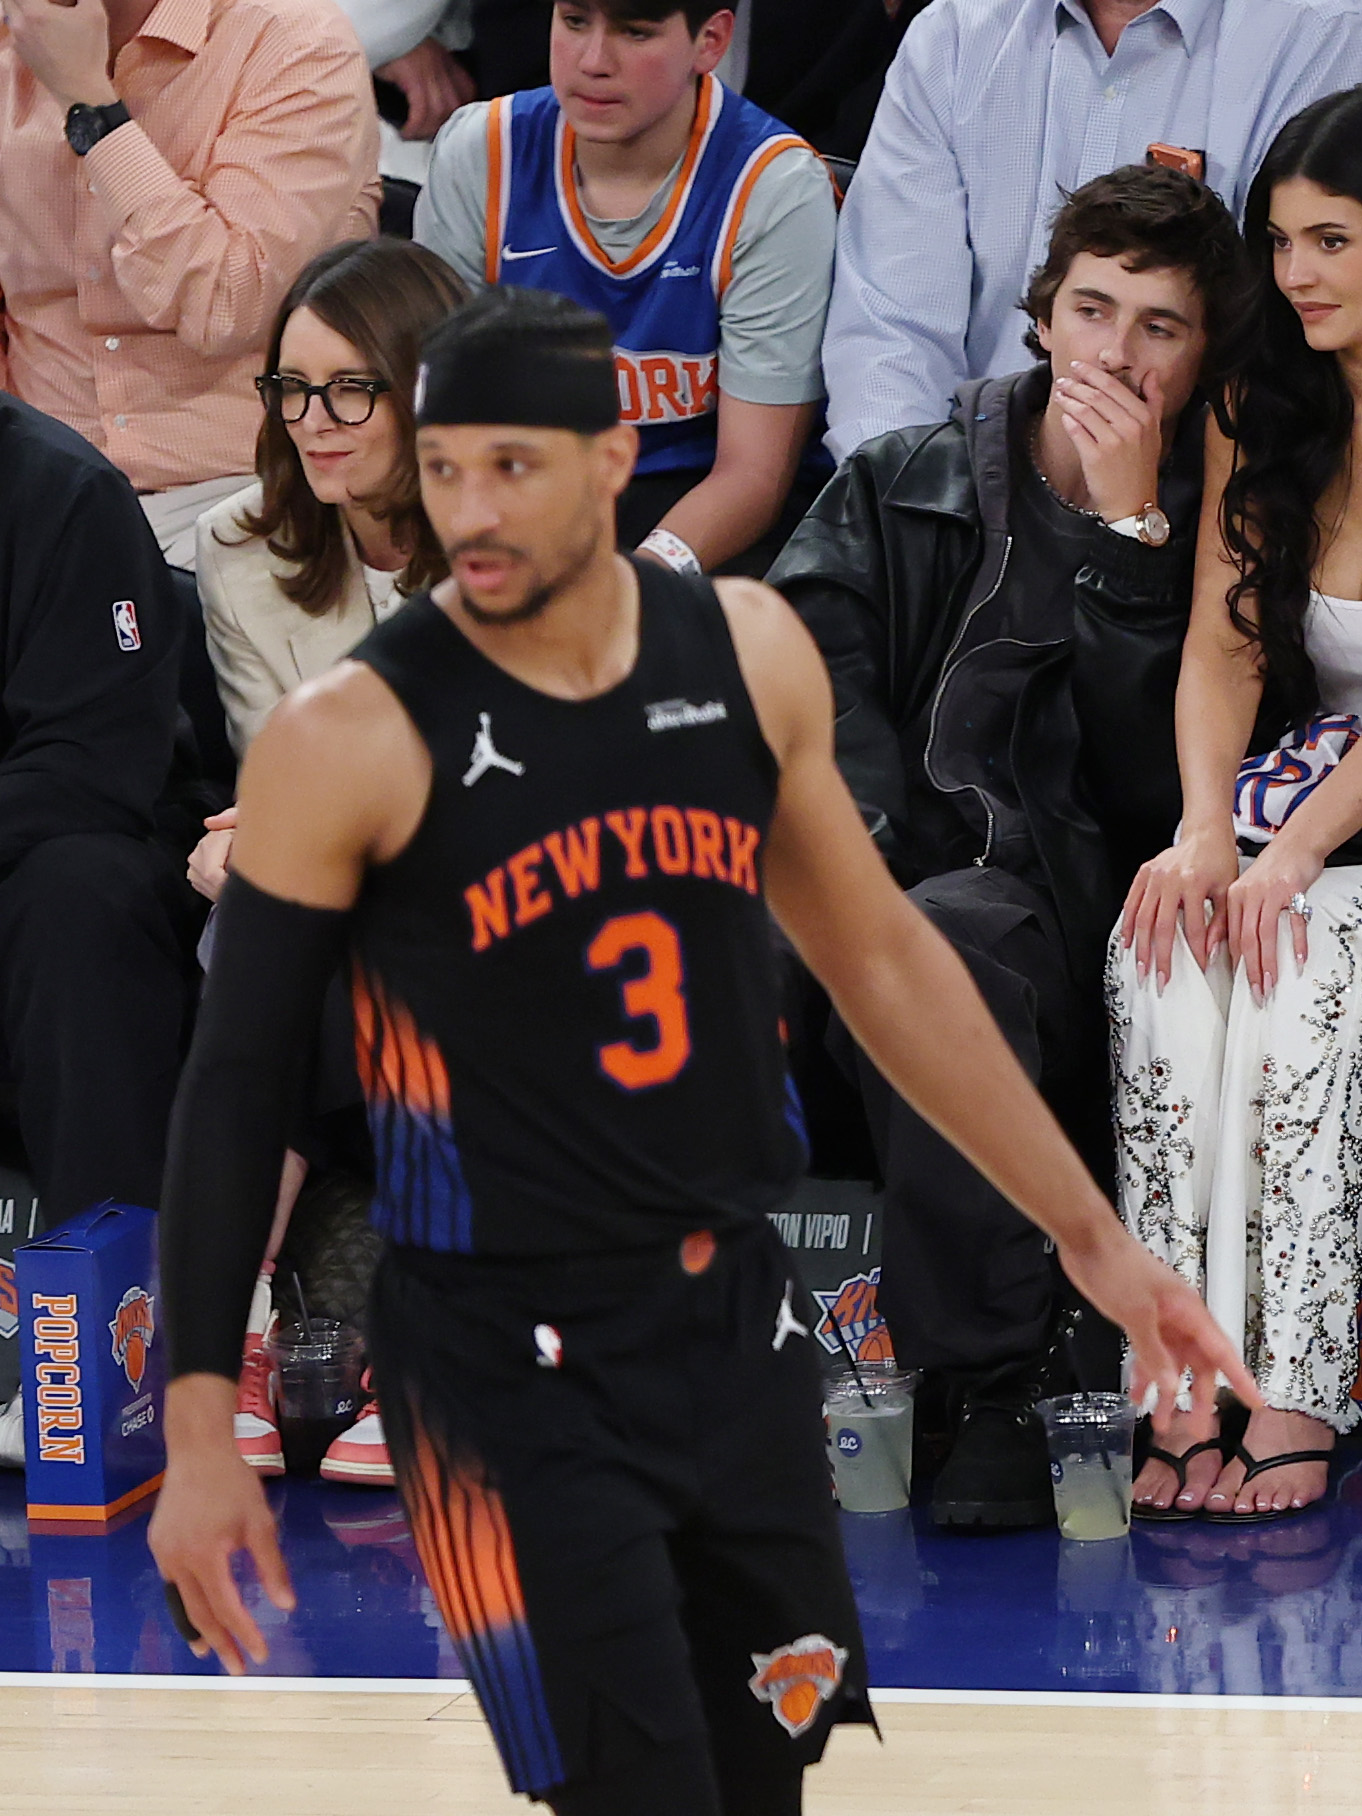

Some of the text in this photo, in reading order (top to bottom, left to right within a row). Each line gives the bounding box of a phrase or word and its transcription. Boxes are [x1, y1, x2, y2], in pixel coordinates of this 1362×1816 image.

[613, 355, 719, 421] ORK
[463, 804, 760, 953] NEW YORK
[586, 909, 692, 1091] 3
[32, 1293, 85, 1465] POPCORN
[121, 1409, 147, 1437] CHASE
